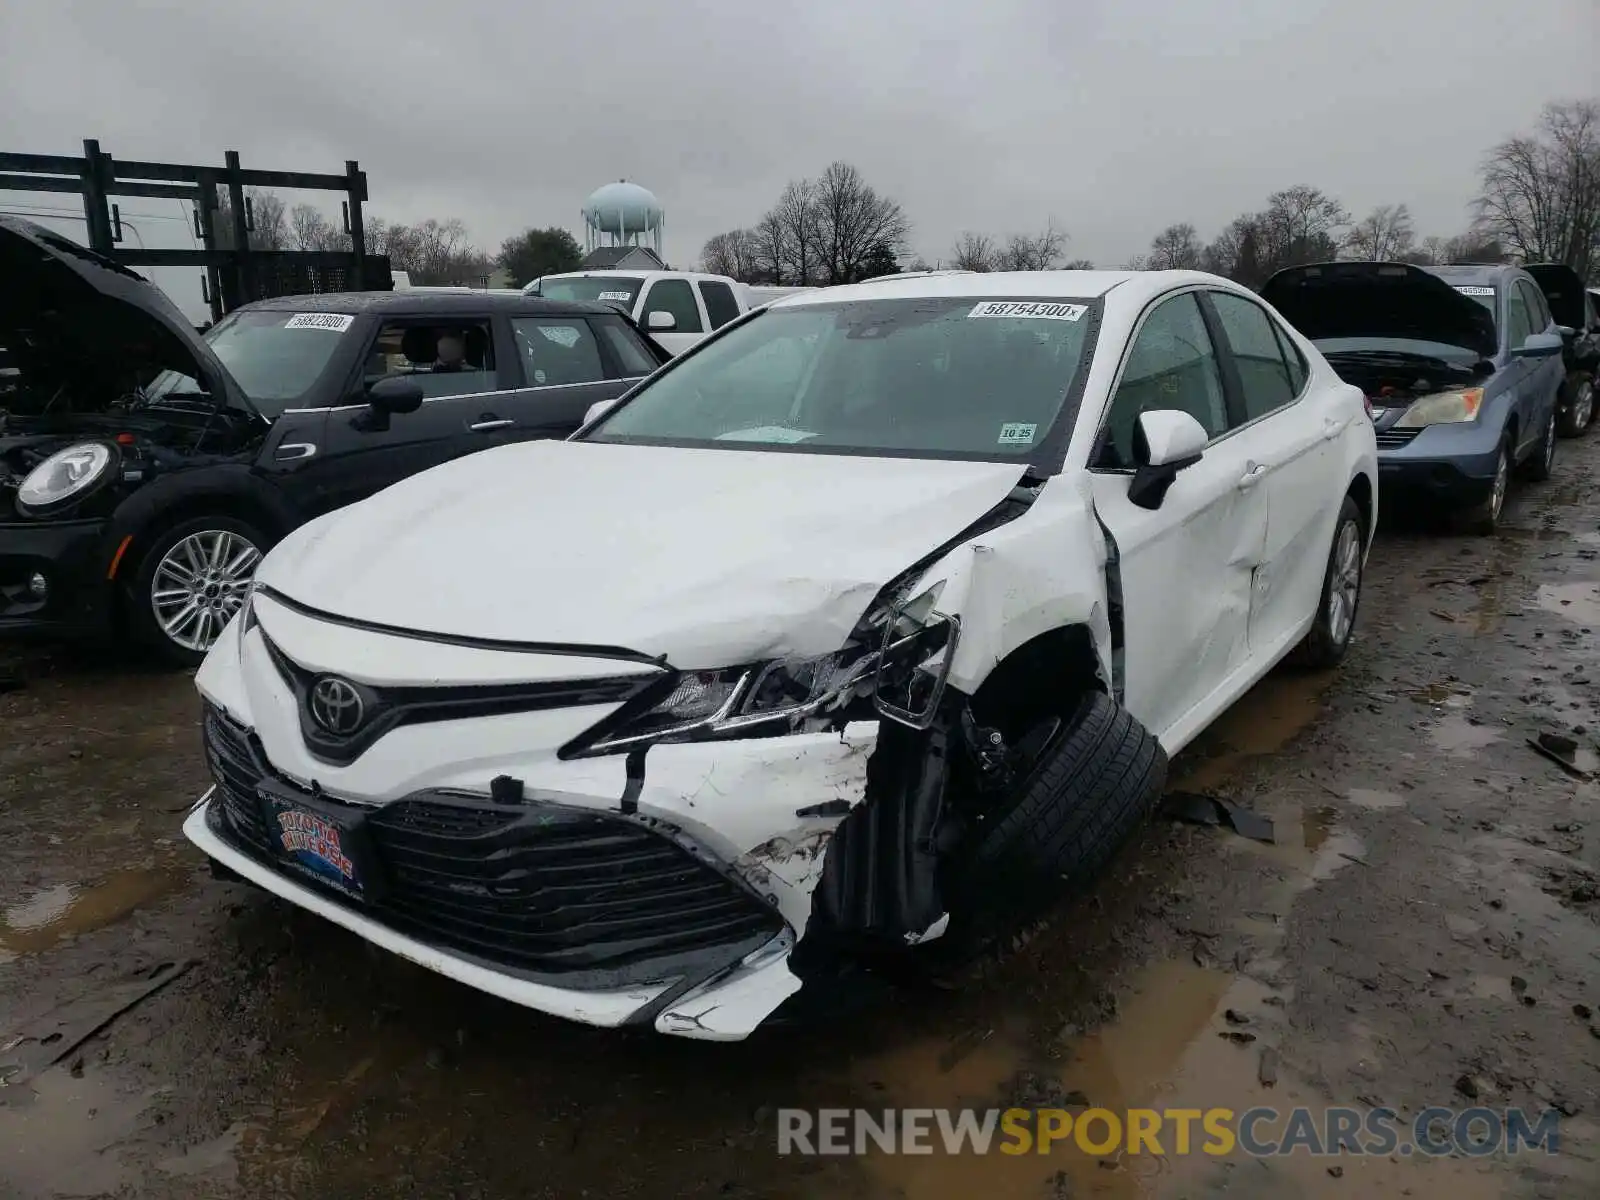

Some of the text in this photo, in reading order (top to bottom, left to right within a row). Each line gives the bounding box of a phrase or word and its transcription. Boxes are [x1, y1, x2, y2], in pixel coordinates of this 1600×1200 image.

[1003, 429, 1032, 438] 10 25
[278, 810, 342, 846] TOYOTA
[280, 830, 354, 880] UNIVERSE
